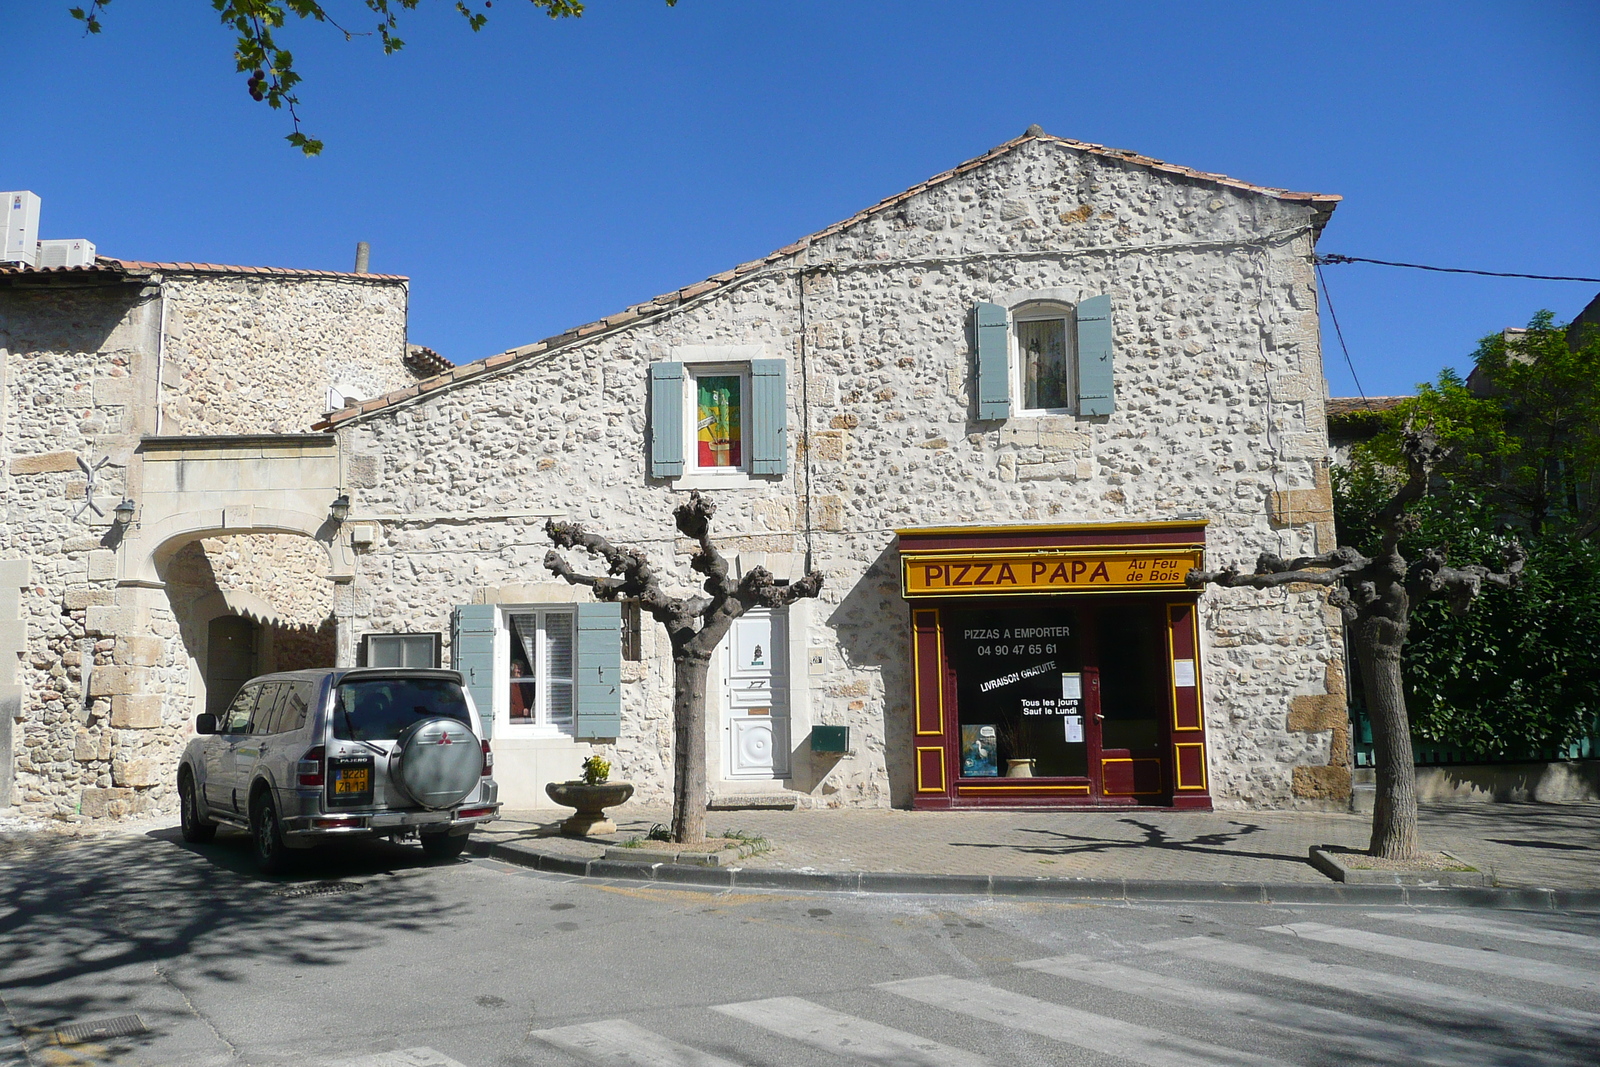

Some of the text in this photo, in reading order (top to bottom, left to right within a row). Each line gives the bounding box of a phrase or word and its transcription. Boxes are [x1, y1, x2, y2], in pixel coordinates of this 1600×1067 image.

[1127, 557, 1178, 570] Au Feu
[925, 561, 1110, 586] PIZZA PAPA
[1126, 570, 1180, 582] de Bois
[964, 627, 1070, 640] PIZZAS A EMPORTER
[977, 643, 1057, 656] 04 90 47 65 61
[980, 661, 1056, 693] LIVRAISON GRATUITE
[1021, 698, 1079, 708] Tous les jours
[1023, 706, 1077, 716] Sauf le Lundi
[343, 769, 365, 779] 9228
[355, 781, 365, 791] 13
